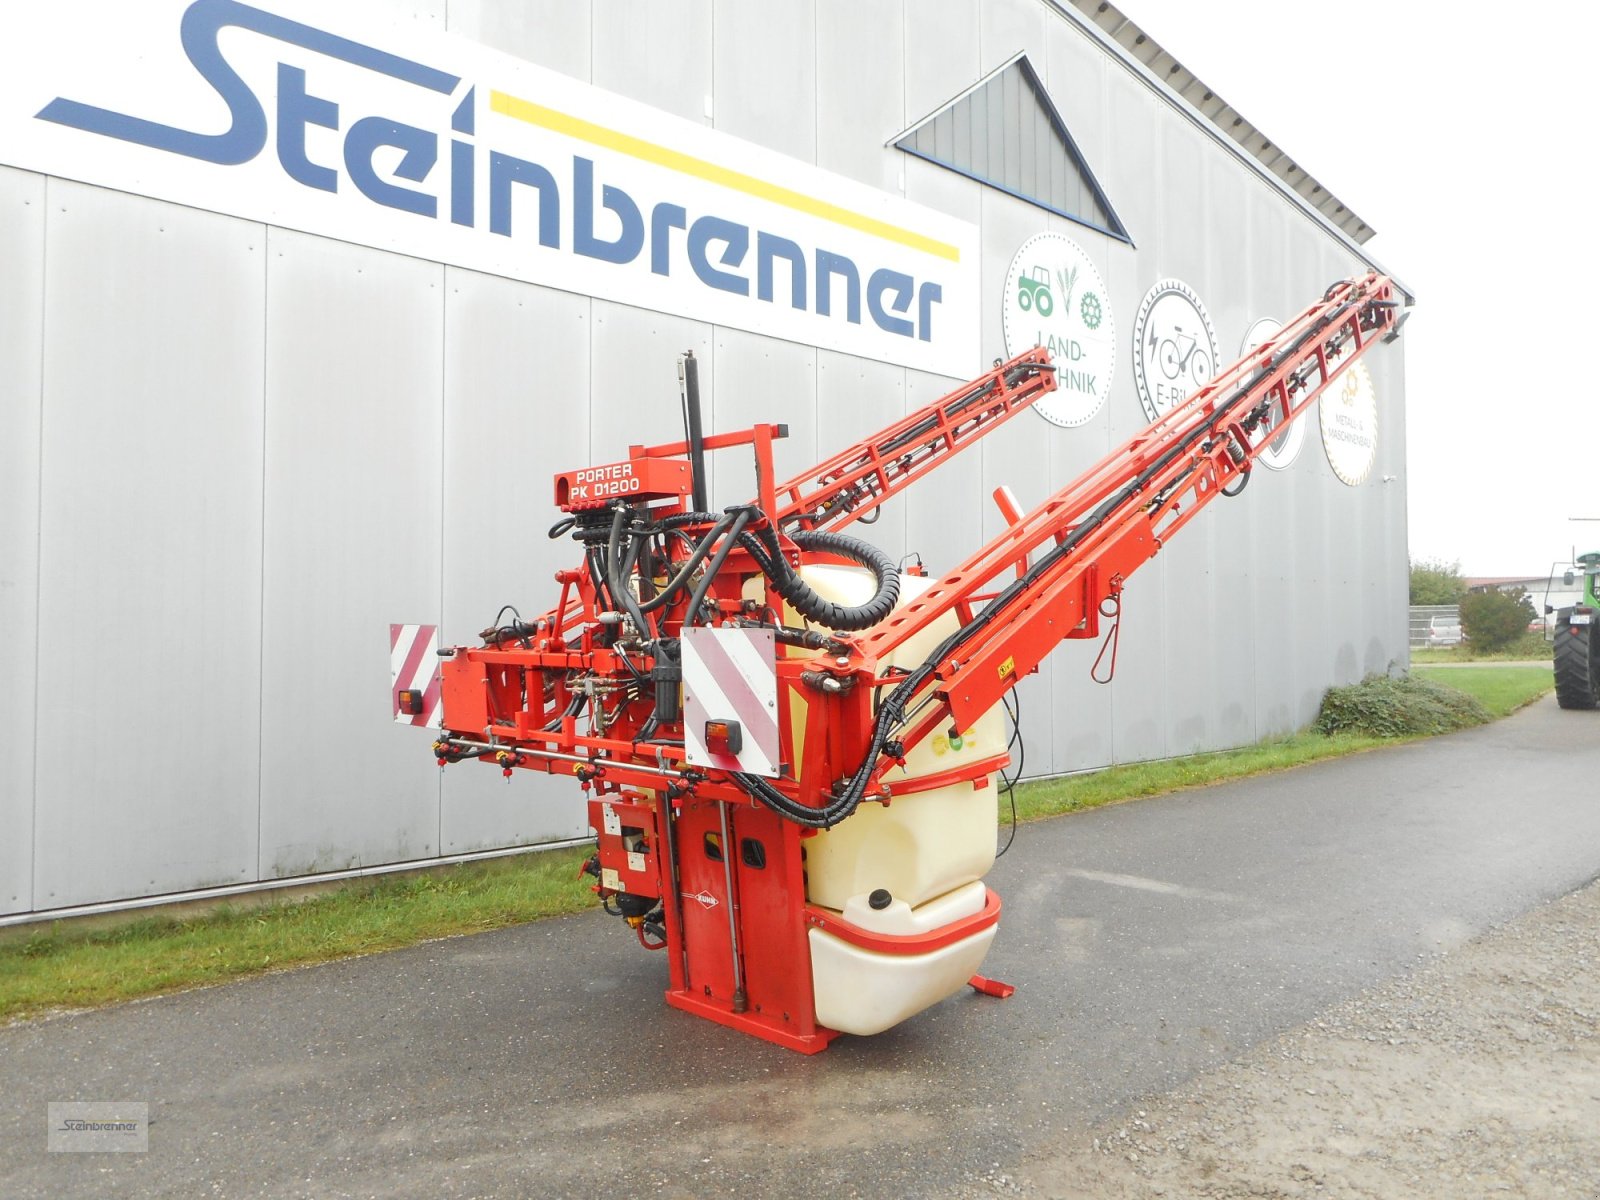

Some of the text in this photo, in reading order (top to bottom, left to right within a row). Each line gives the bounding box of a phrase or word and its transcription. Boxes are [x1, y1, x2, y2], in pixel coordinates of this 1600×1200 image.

[34, 0, 942, 343] Steinbrenner
[1058, 366, 1097, 395] HNIK
[576, 463, 632, 485] PORTER
[571, 477, 640, 500] PK D1200
